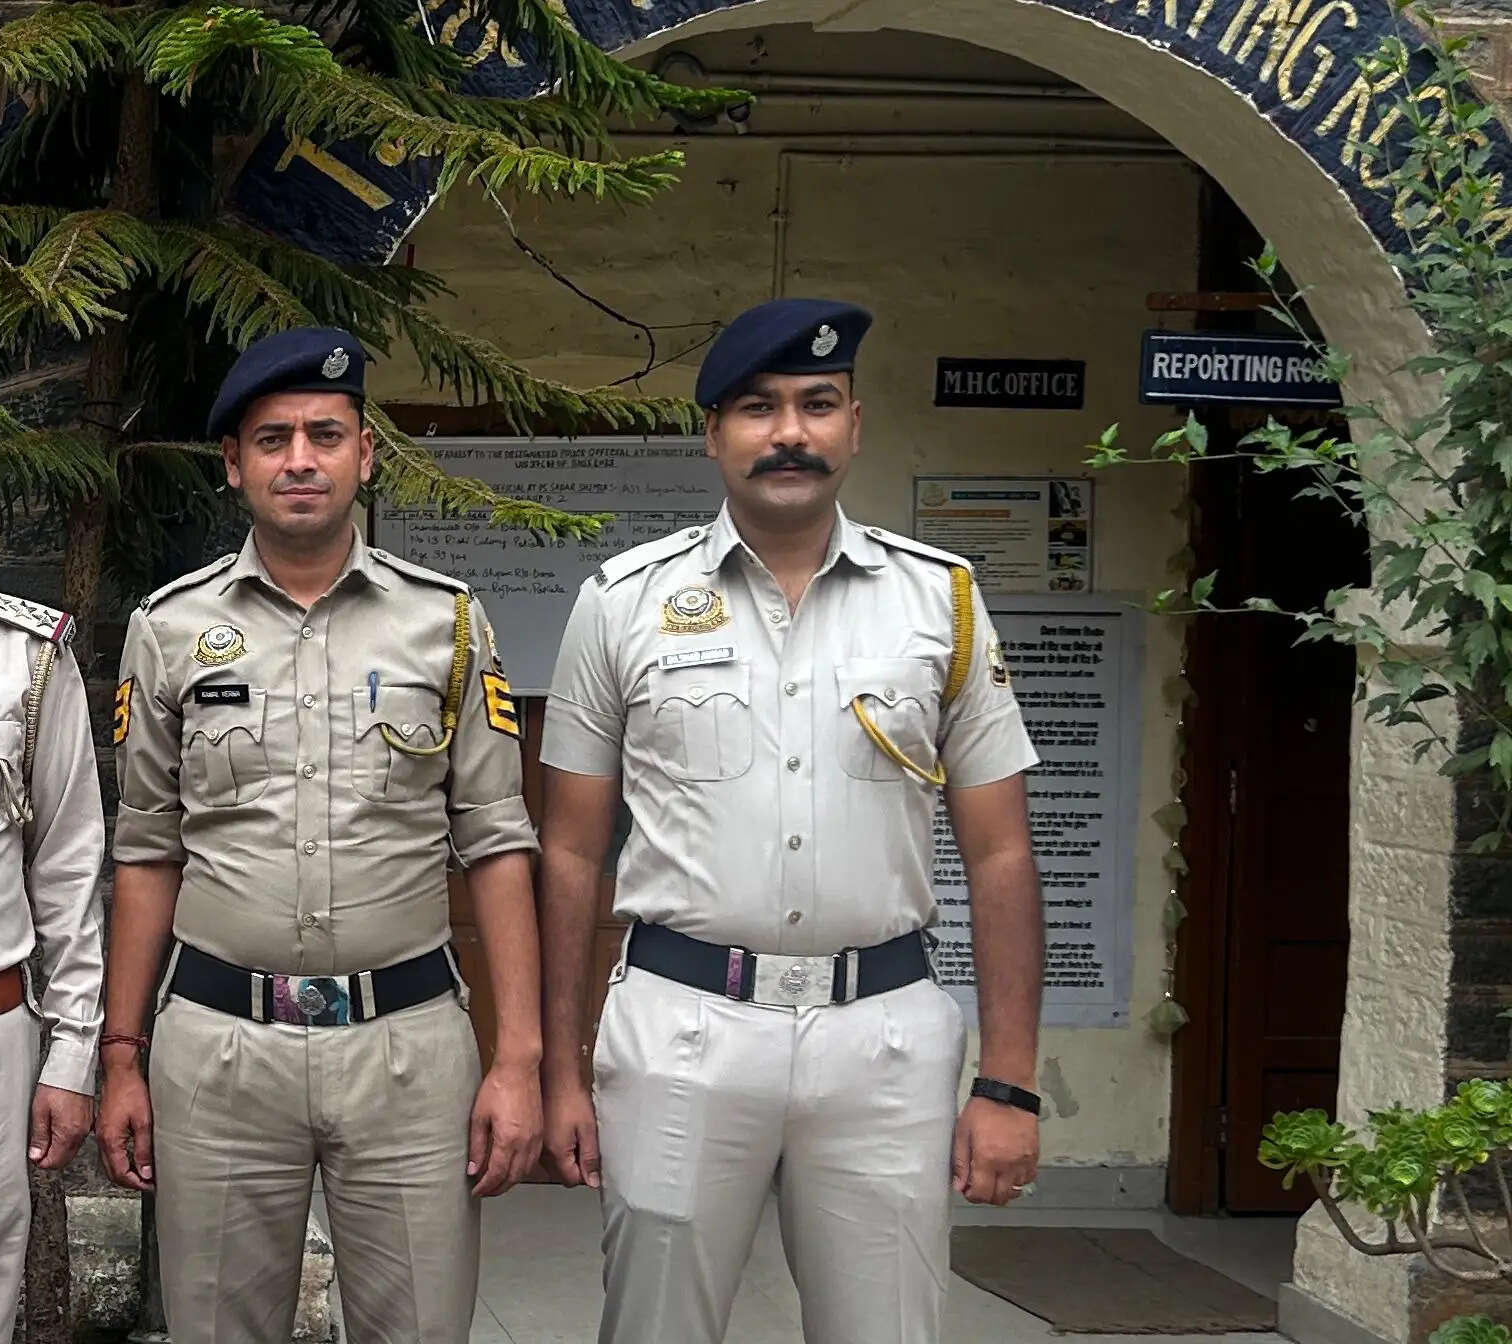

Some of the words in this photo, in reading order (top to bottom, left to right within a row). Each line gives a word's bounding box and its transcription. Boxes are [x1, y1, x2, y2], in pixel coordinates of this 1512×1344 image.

[1313, 35, 1512, 254] ROO
[1152, 352, 1283, 384] REPORTING
[1285, 356, 1336, 384] ROO
[1005, 372, 1078, 397] OFFICE
